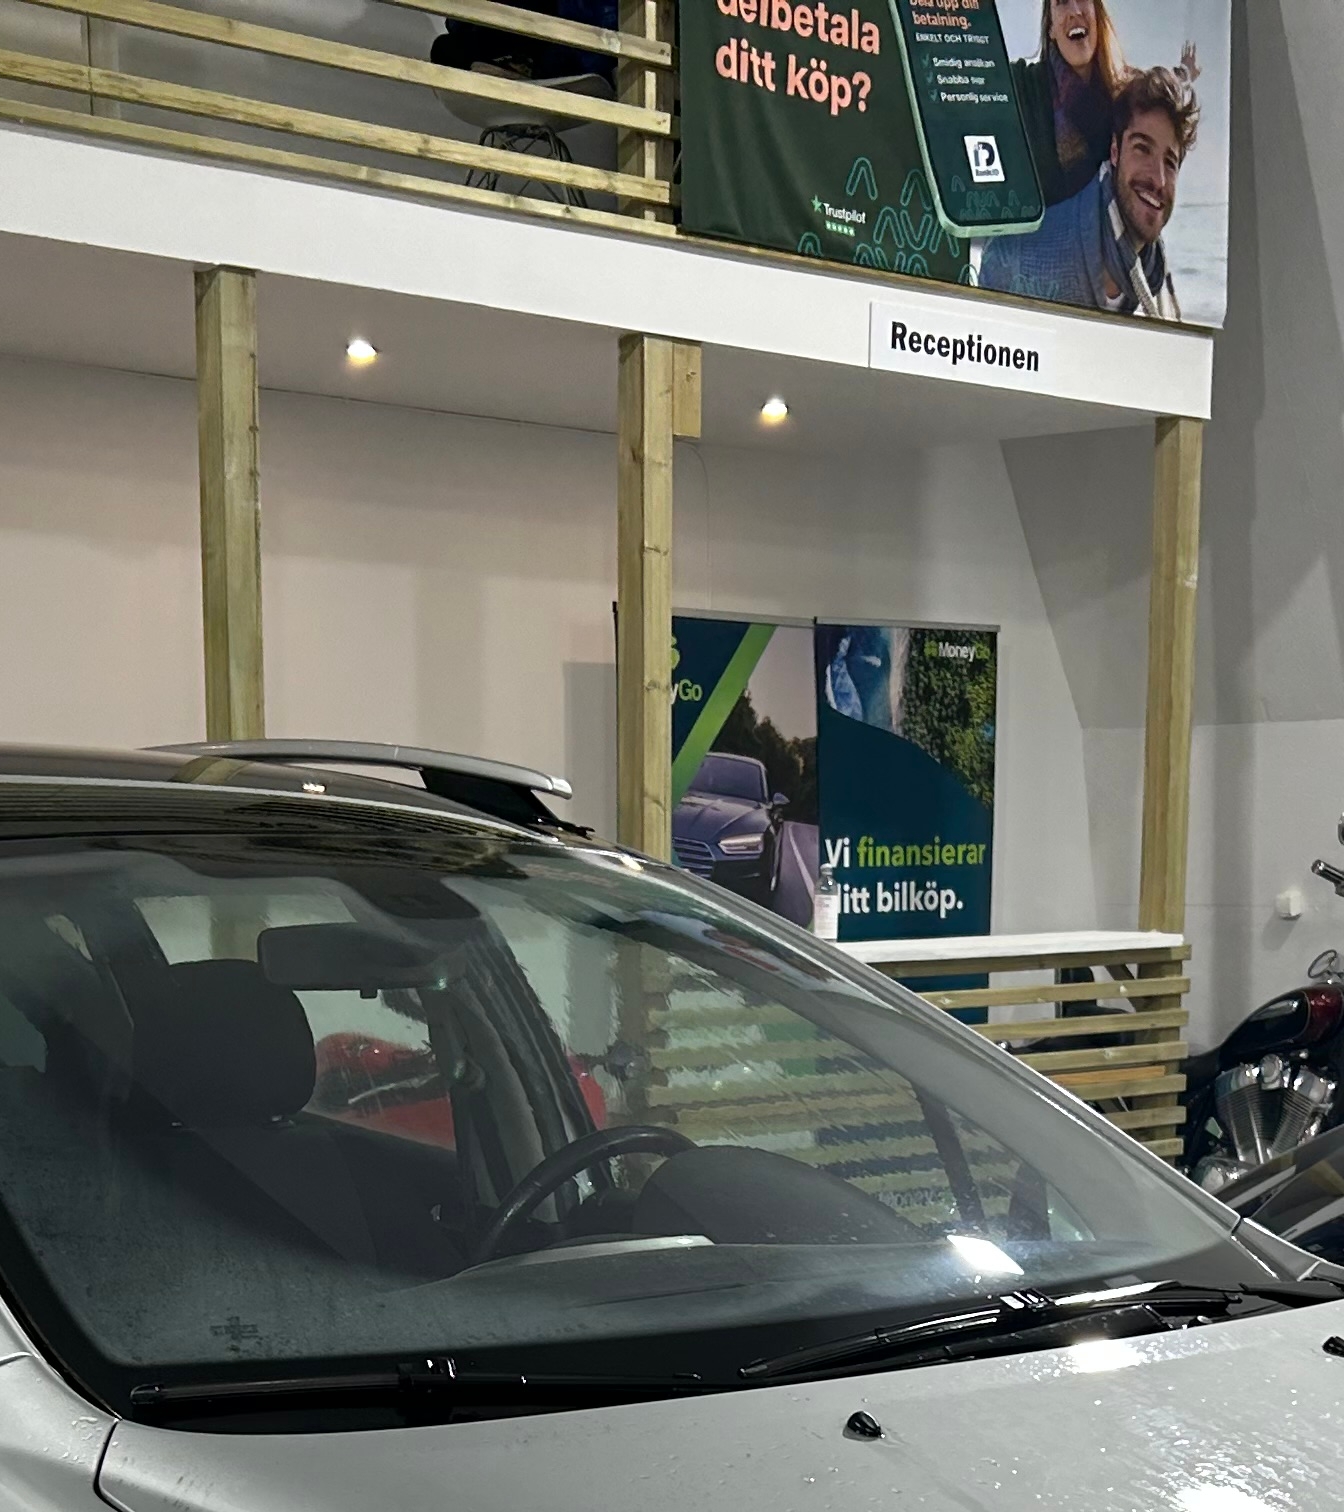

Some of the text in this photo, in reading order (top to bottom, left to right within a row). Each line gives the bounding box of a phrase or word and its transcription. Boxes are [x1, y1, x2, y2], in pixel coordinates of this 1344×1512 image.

[911, 10, 972, 30] betalning.
[943, 33, 962, 43] OCH
[716, 38, 872, 116] ditt köp?
[823, 202, 866, 224] Trustpilot
[891, 320, 1039, 372] Receptionen
[938, 641, 991, 662] MoneyGo
[825, 836, 986, 868] Vi finansierar
[876, 880, 964, 919] bilköp.
